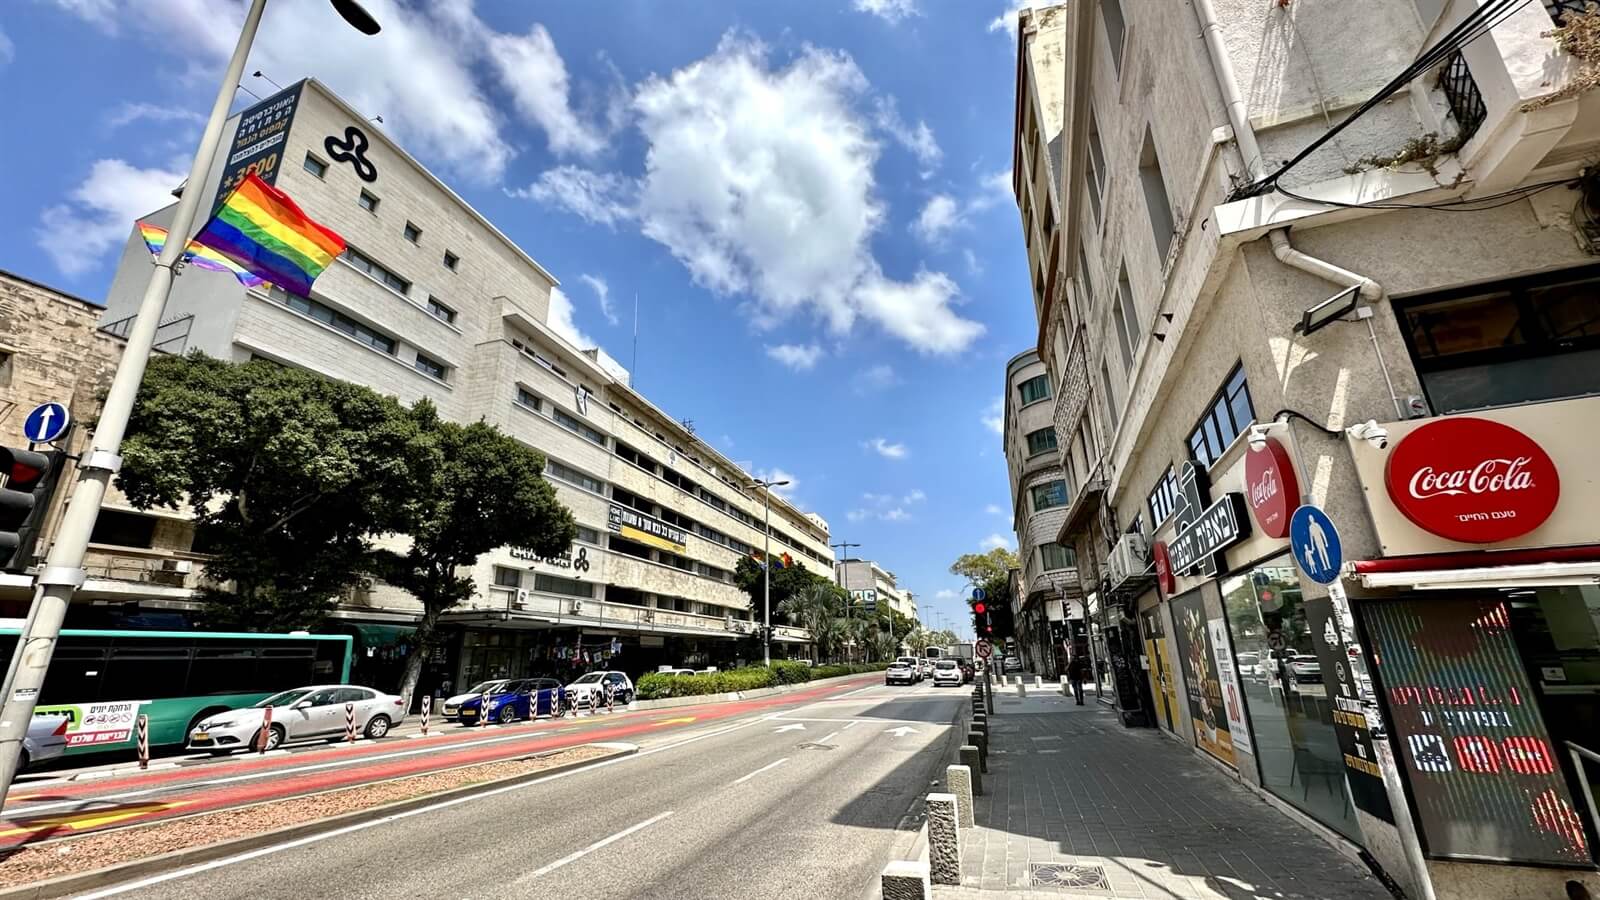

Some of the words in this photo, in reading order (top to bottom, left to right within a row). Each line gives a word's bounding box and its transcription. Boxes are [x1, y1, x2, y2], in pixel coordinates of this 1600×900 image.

[242, 95, 295, 128] האוניברסיטה
[260, 118, 288, 138] קמפוס
[1408, 457, 1533, 499] Coca-Cola
[1252, 466, 1278, 508] Coca-Cola
[1459, 512, 1490, 522] החיים
[1491, 510, 1516, 520] טעם
[90, 706, 106, 714] יונים
[108, 704, 132, 713] הרחקת
